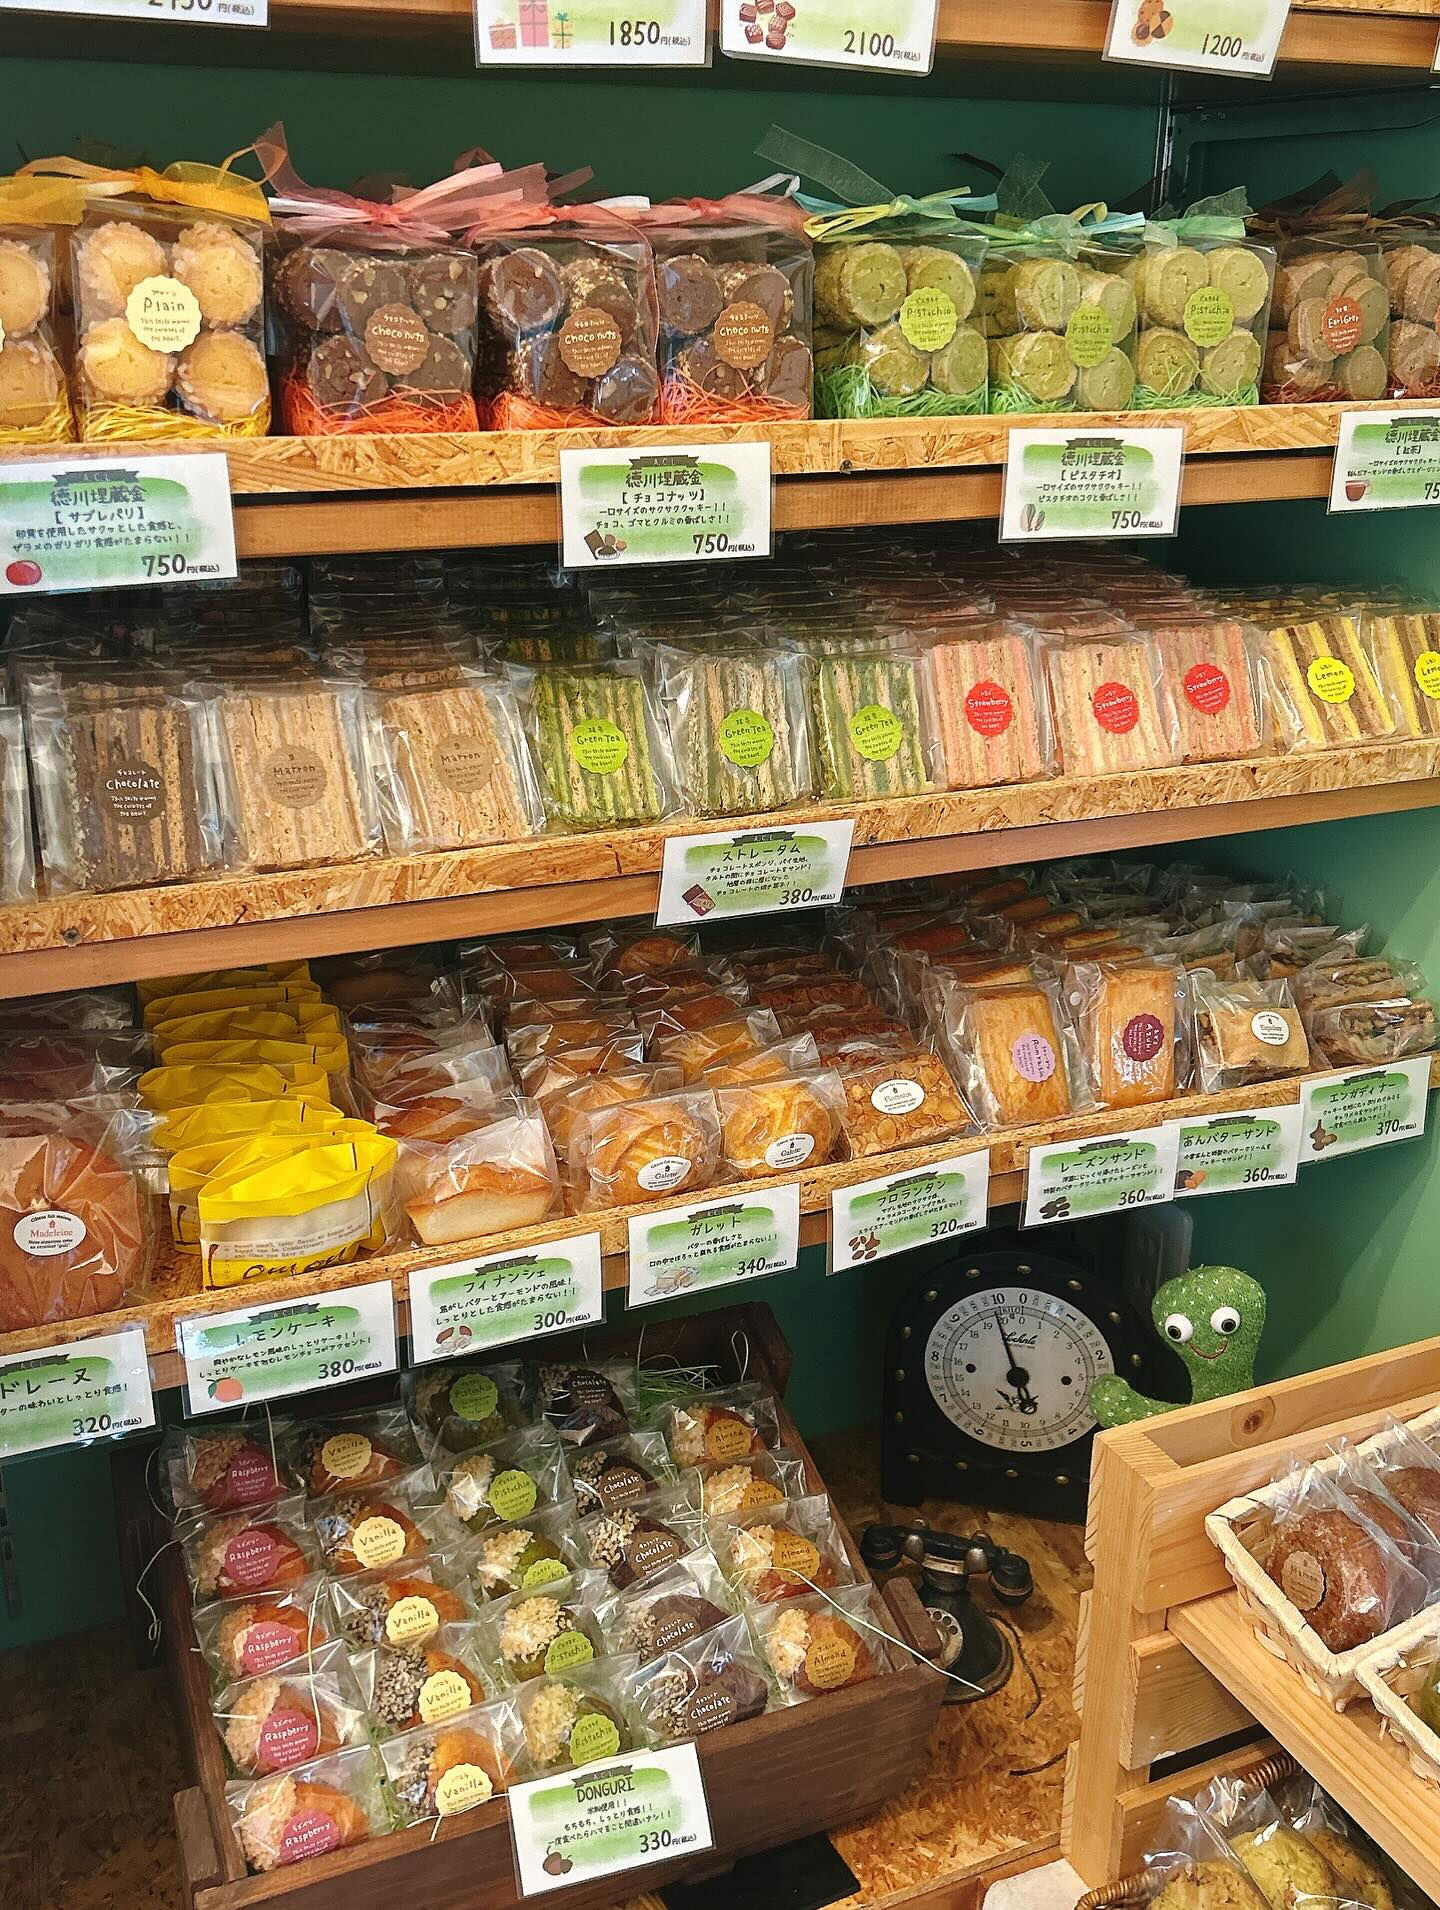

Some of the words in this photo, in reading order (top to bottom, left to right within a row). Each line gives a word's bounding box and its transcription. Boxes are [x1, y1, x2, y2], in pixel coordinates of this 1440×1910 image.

[143, 297, 185, 313] Plain
[907, 307, 951, 319] Pistachio
[1191, 306, 1229, 315] Pistachio
[372, 325, 402, 338] Choco
[720, 325, 748, 336] Choco
[565, 334, 594, 345] Choco
[1061, 451, 1126, 467] 徳川埋蔵金
[625, 469, 704, 488] 徳川埋蔵金
[1061, 469, 1122, 481] 【ピスタチオ】
[51, 485, 146, 507] 徳川埋蔵金
[622, 489, 705, 504] 【チョコナッツ】
[55, 506, 145, 524] 【サブレパリ】
[1315, 670, 1344, 680] Lemon
[1187, 675, 1223, 692] Strawberry
[968, 698, 1008, 708] Strawberry
[1095, 695, 1132, 711] Strawberry
[725, 727, 750, 738] Green
[752, 726, 766, 734] Tea
[856, 723, 878, 735] Green
[880, 719, 894, 728] Tea
[577, 736, 603, 745] Green
[606, 735, 620, 743] Tea
[440, 752, 480, 765] Marron
[273, 765, 315, 777] Marron
[106, 778, 160, 790] Chocolate
[723, 844, 800, 862] ストレータム
[1330, 1082, 1396, 1103] エンガディナー
[1183, 1126, 1277, 1148] あんバターサンド
[1060, 1148, 1146, 1173] レーズンサンド
[878, 1180, 946, 1207] フロランタン
[30, 1229, 73, 1238] Madeleine
[690, 1216, 741, 1236] ガレット
[464, 1269, 546, 1293] フィナンシェ
[991, 1293, 1005, 1305] 10
[1019, 1293, 1028, 1304] 0
[931, 1351, 940, 1361] 8
[1097, 1350, 1105, 1361] 2
[715, 1430, 744, 1443] Almond
[328, 1440, 364, 1457] Vanilla
[232, 1465, 269, 1478] Raspberry
[494, 1482, 530, 1498] Pistachio
[603, 1475, 640, 1493] Chocolate
[359, 1528, 397, 1547] Vanilla
[229, 1543, 272, 1561] Raspberry
[635, 1540, 673, 1563] Chocolate
[781, 1547, 811, 1558] Almond
[393, 1609, 431, 1628] Vanilla
[656, 1622, 695, 1647] Chocolate
[247, 1636, 292, 1655] Raspberry
[550, 1643, 588, 1664] Pistachio
[814, 1650, 846, 1665] Almond
[426, 1683, 463, 1706] Vanilla
[690, 1696, 731, 1719] Chocolate
[264, 1724, 310, 1742] Raspberry
[575, 1724, 613, 1747] Pistachio
[443, 1778, 484, 1799] Vanilla
[576, 1776, 635, 1803] DONGURI
[285, 1822, 332, 1848] Raspberry
